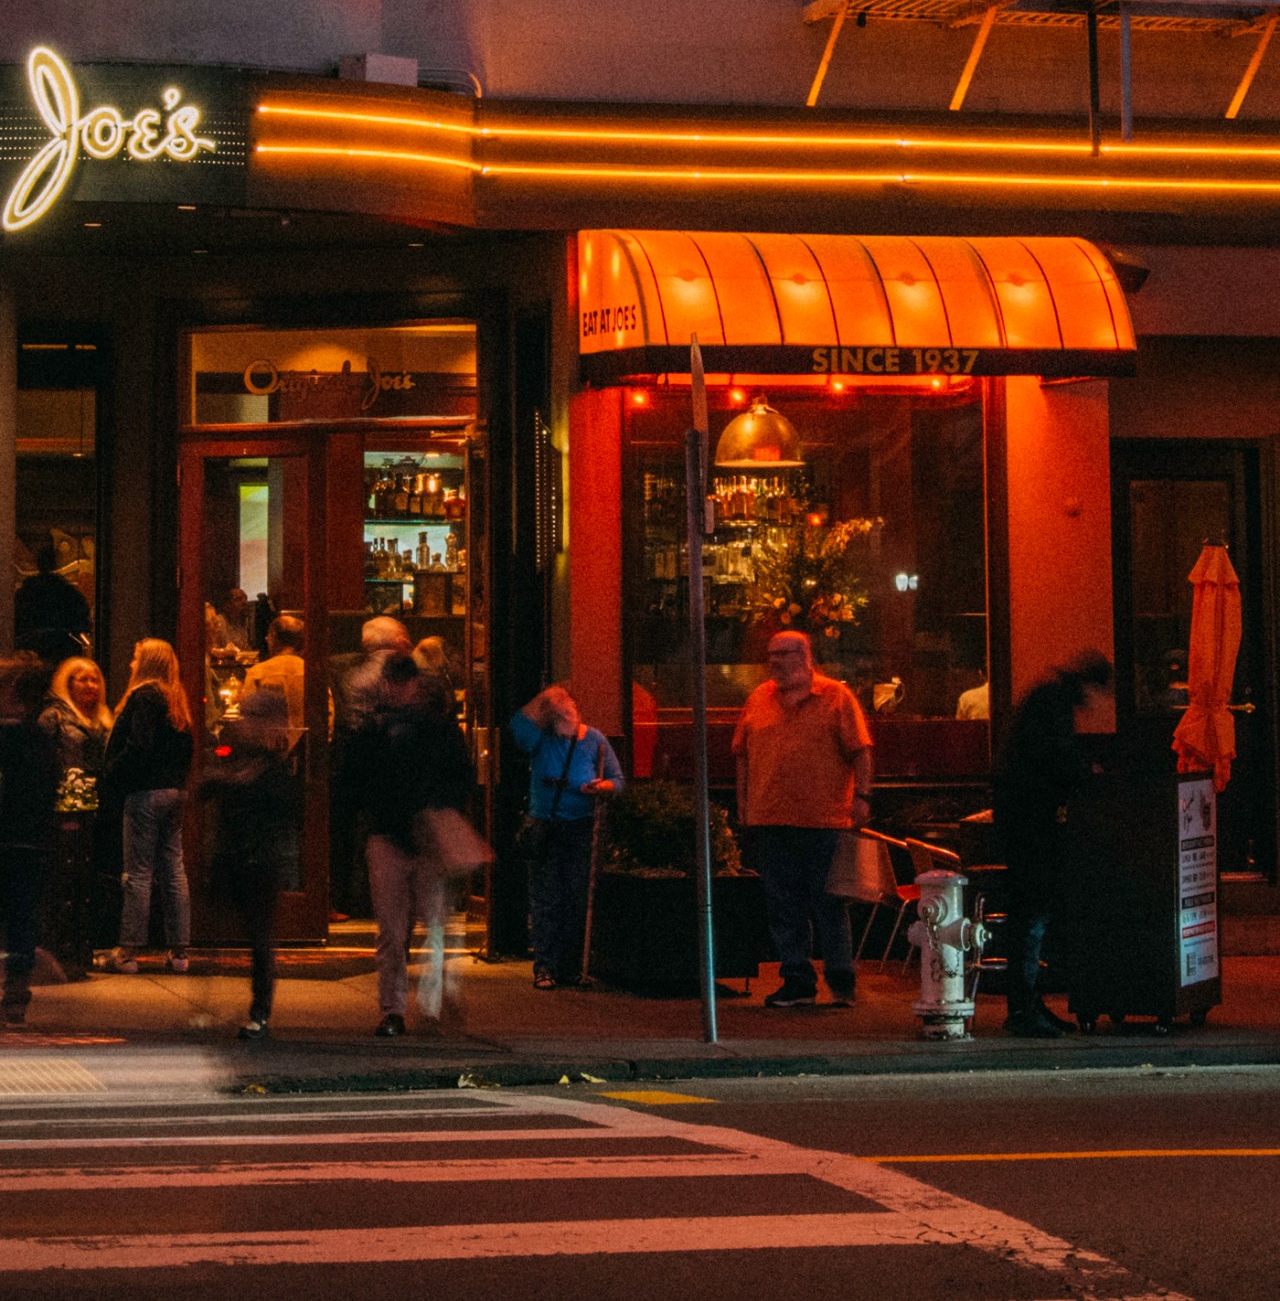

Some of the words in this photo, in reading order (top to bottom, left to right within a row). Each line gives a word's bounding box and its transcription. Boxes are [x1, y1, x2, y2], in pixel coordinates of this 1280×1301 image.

[2, 45, 216, 232] Joe's
[583, 311, 598, 336] EAT
[600, 308, 611, 334] AT
[612, 304, 637, 332] JOE'S
[812, 348, 900, 372] SINCE
[911, 349, 979, 373] 1937
